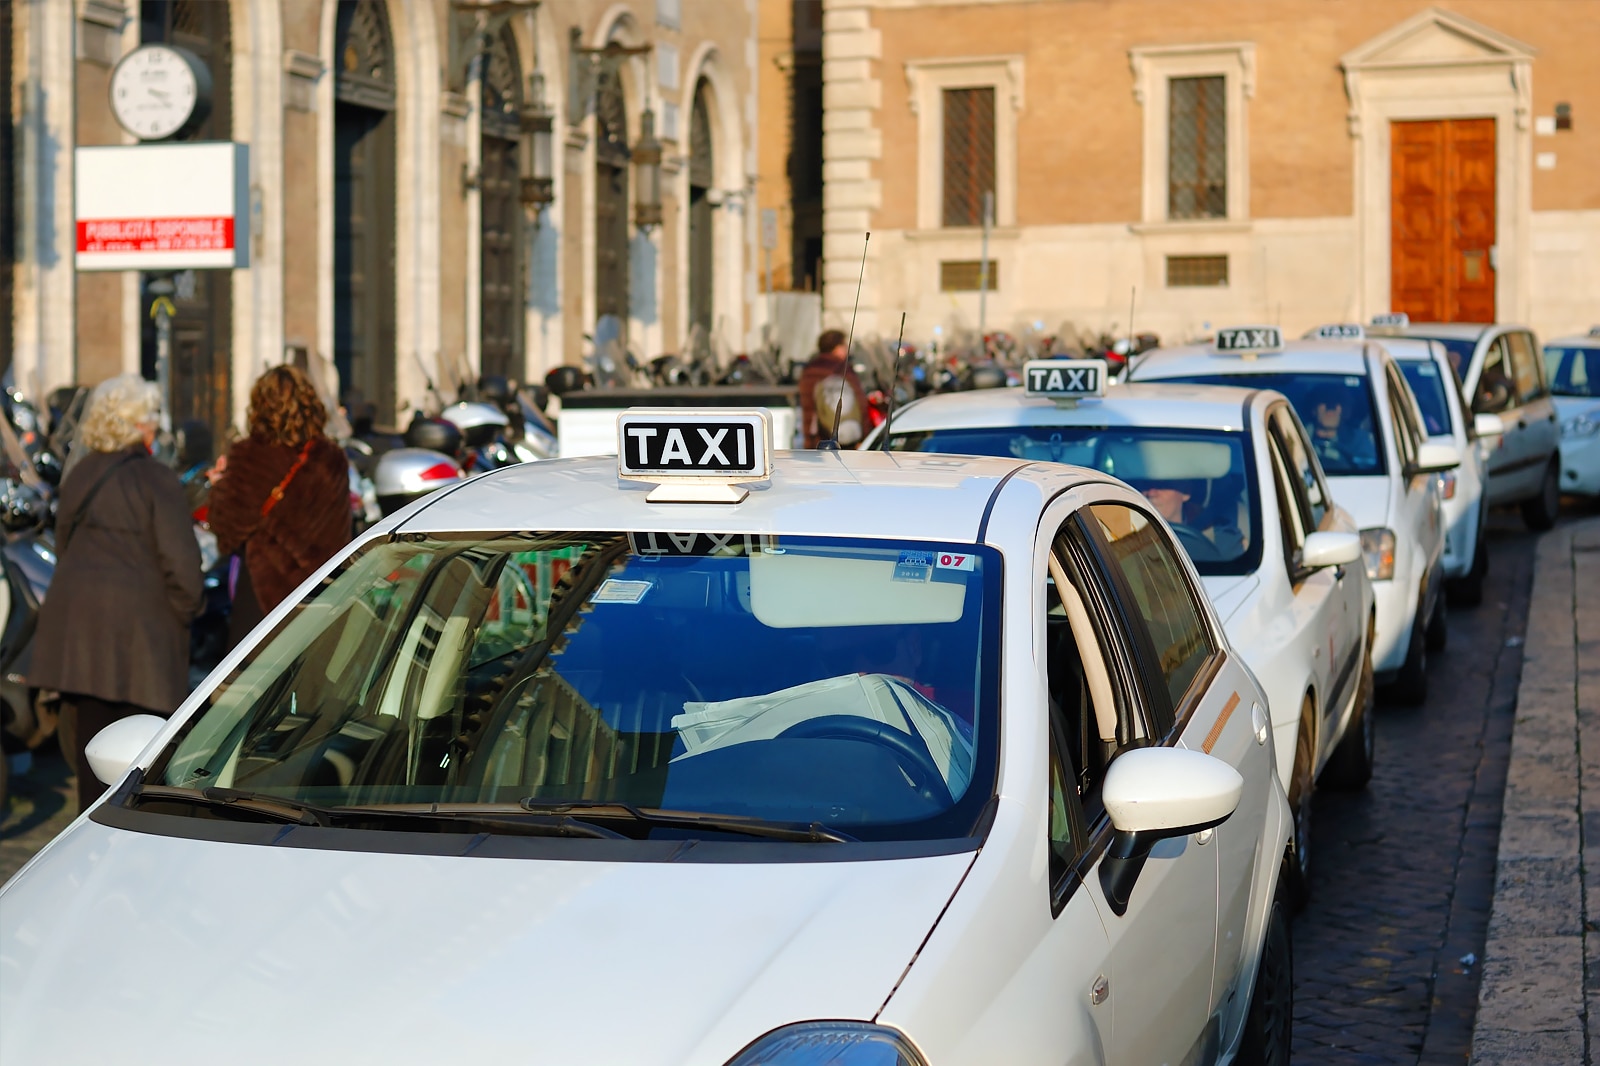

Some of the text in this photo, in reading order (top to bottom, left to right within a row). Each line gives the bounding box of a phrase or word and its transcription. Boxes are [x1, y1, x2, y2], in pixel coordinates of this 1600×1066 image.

[1221, 330, 1275, 348] TAXI
[1029, 368, 1094, 391] TAXI
[627, 427, 748, 466] TAXI
[940, 554, 966, 567] 07
